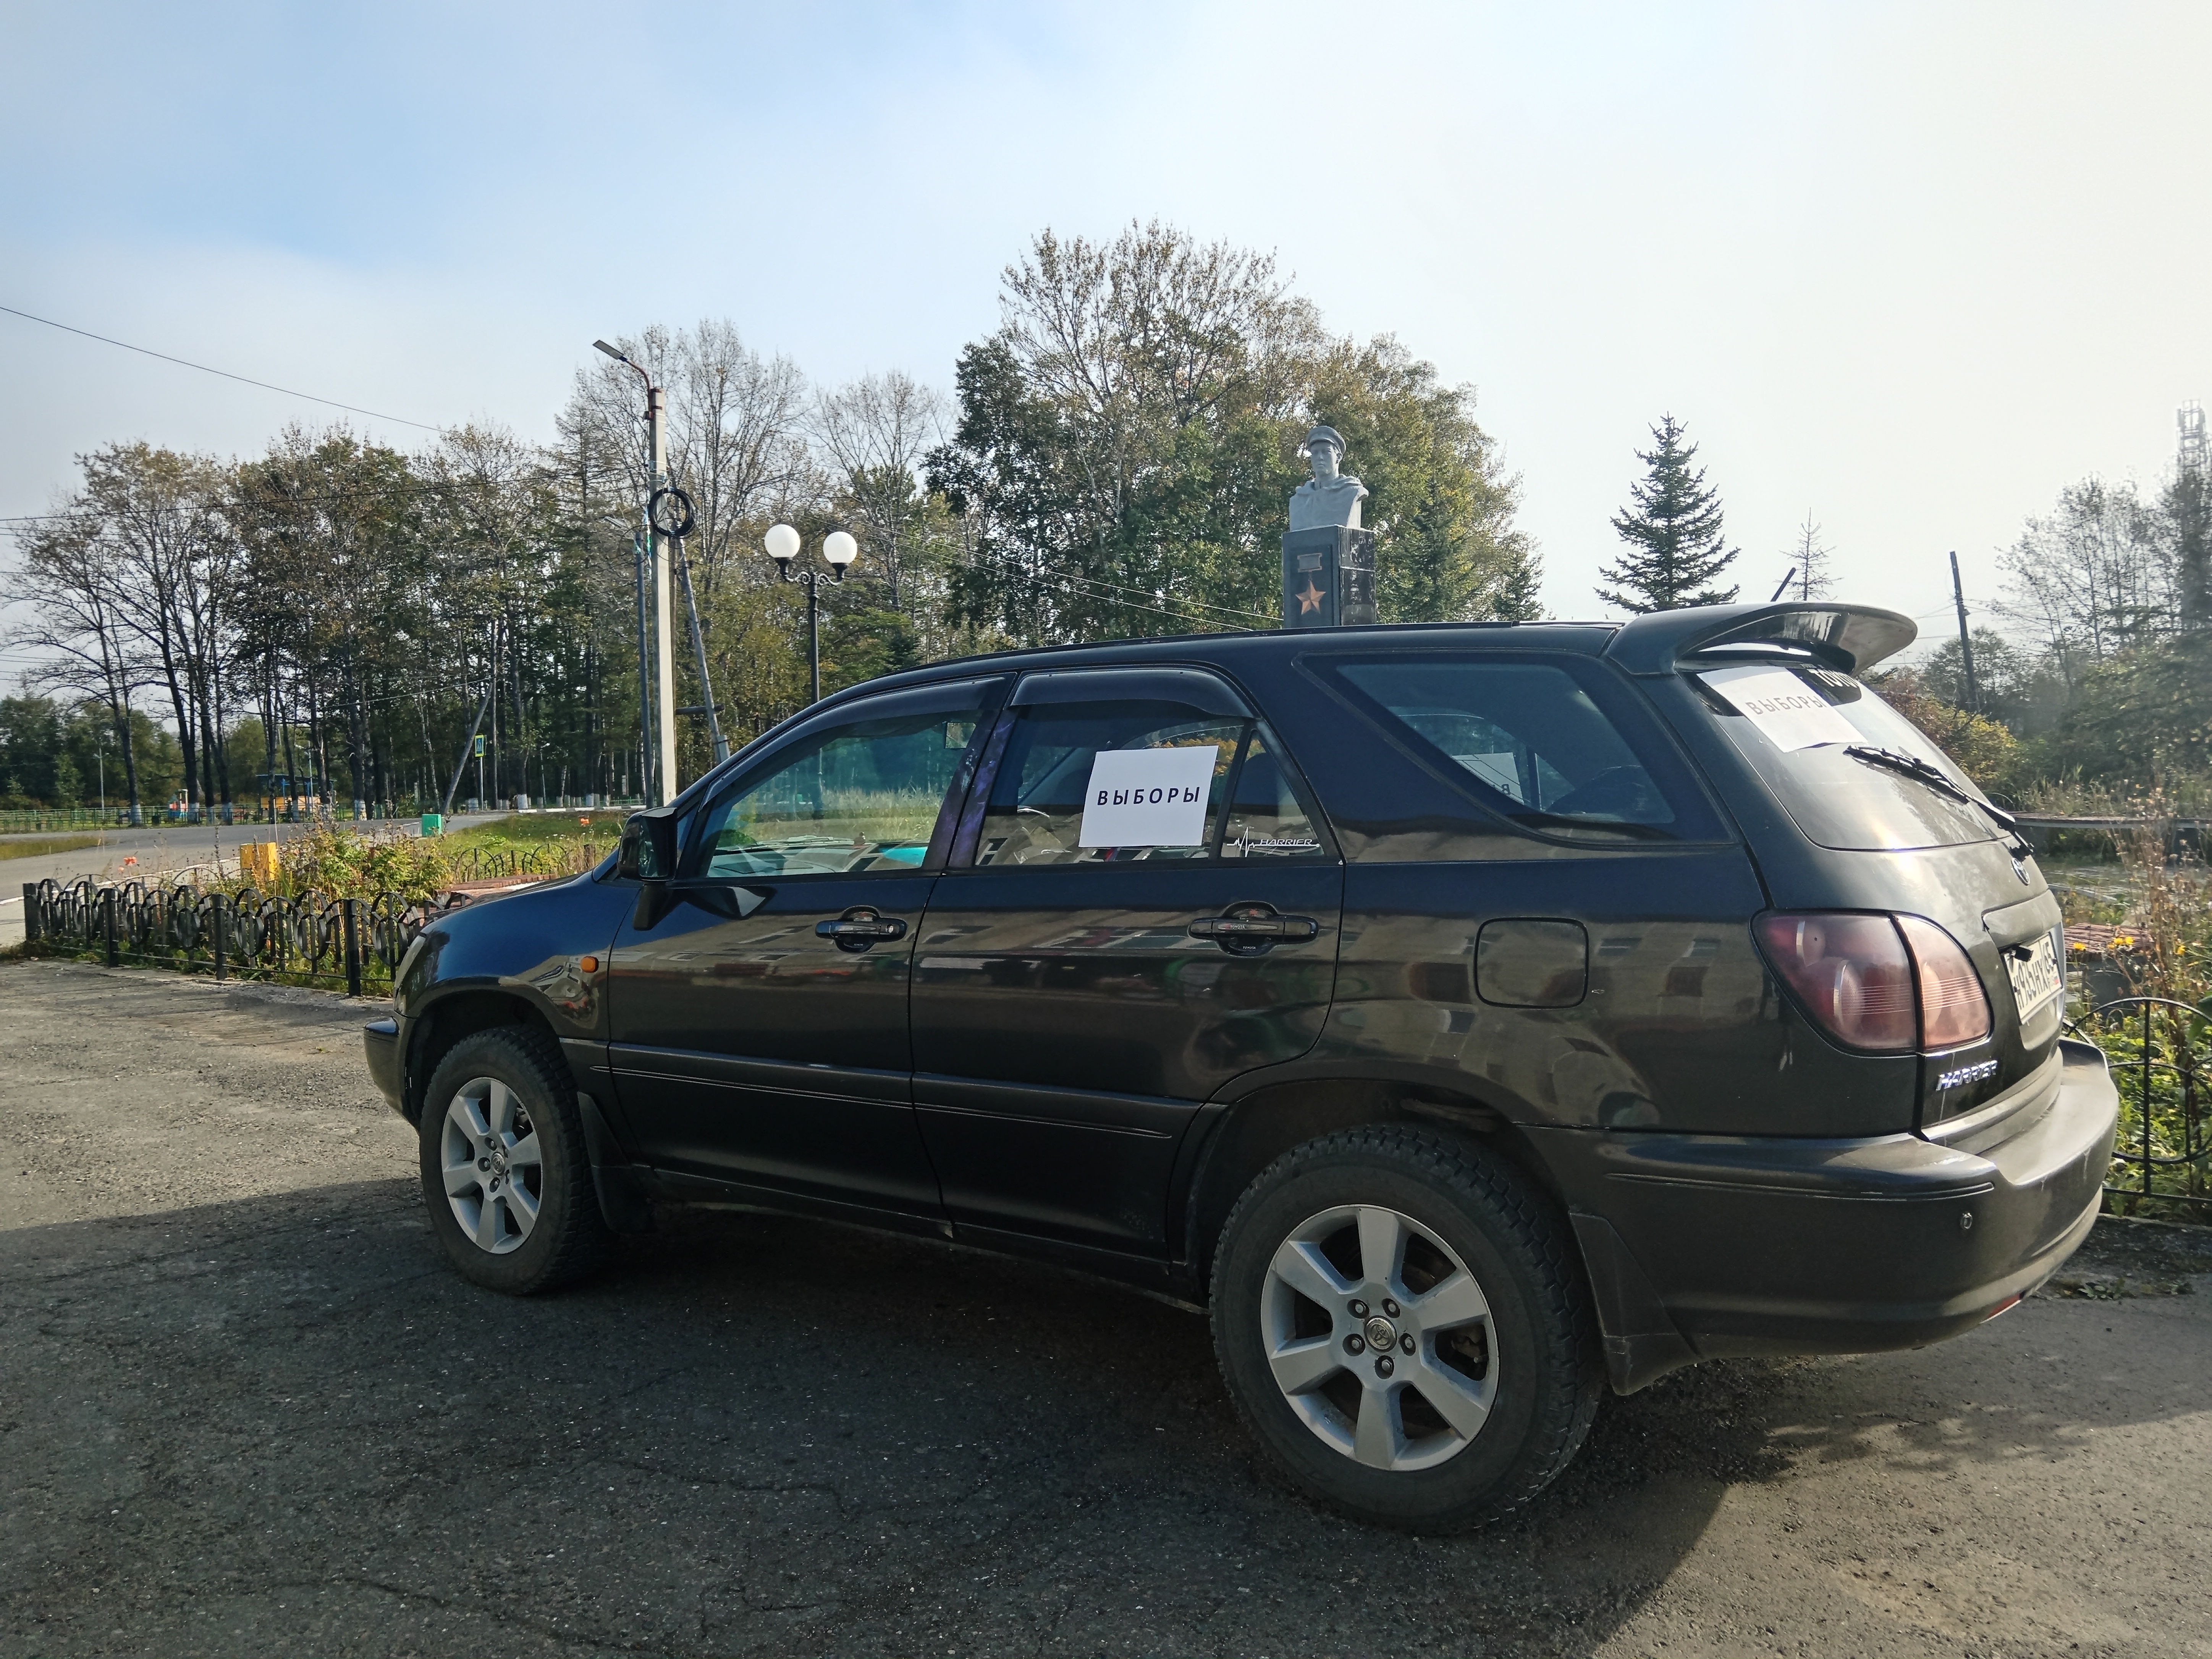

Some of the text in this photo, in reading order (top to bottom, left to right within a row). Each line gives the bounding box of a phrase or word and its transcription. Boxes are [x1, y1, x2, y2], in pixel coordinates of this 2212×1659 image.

[1806, 669, 1859, 688] TOYO
[1745, 695, 1827, 715] ВЫБОРЫ
[1097, 786, 1200, 805] ВЫБОРЫ
[1936, 1060, 1998, 1091] HARRIER
